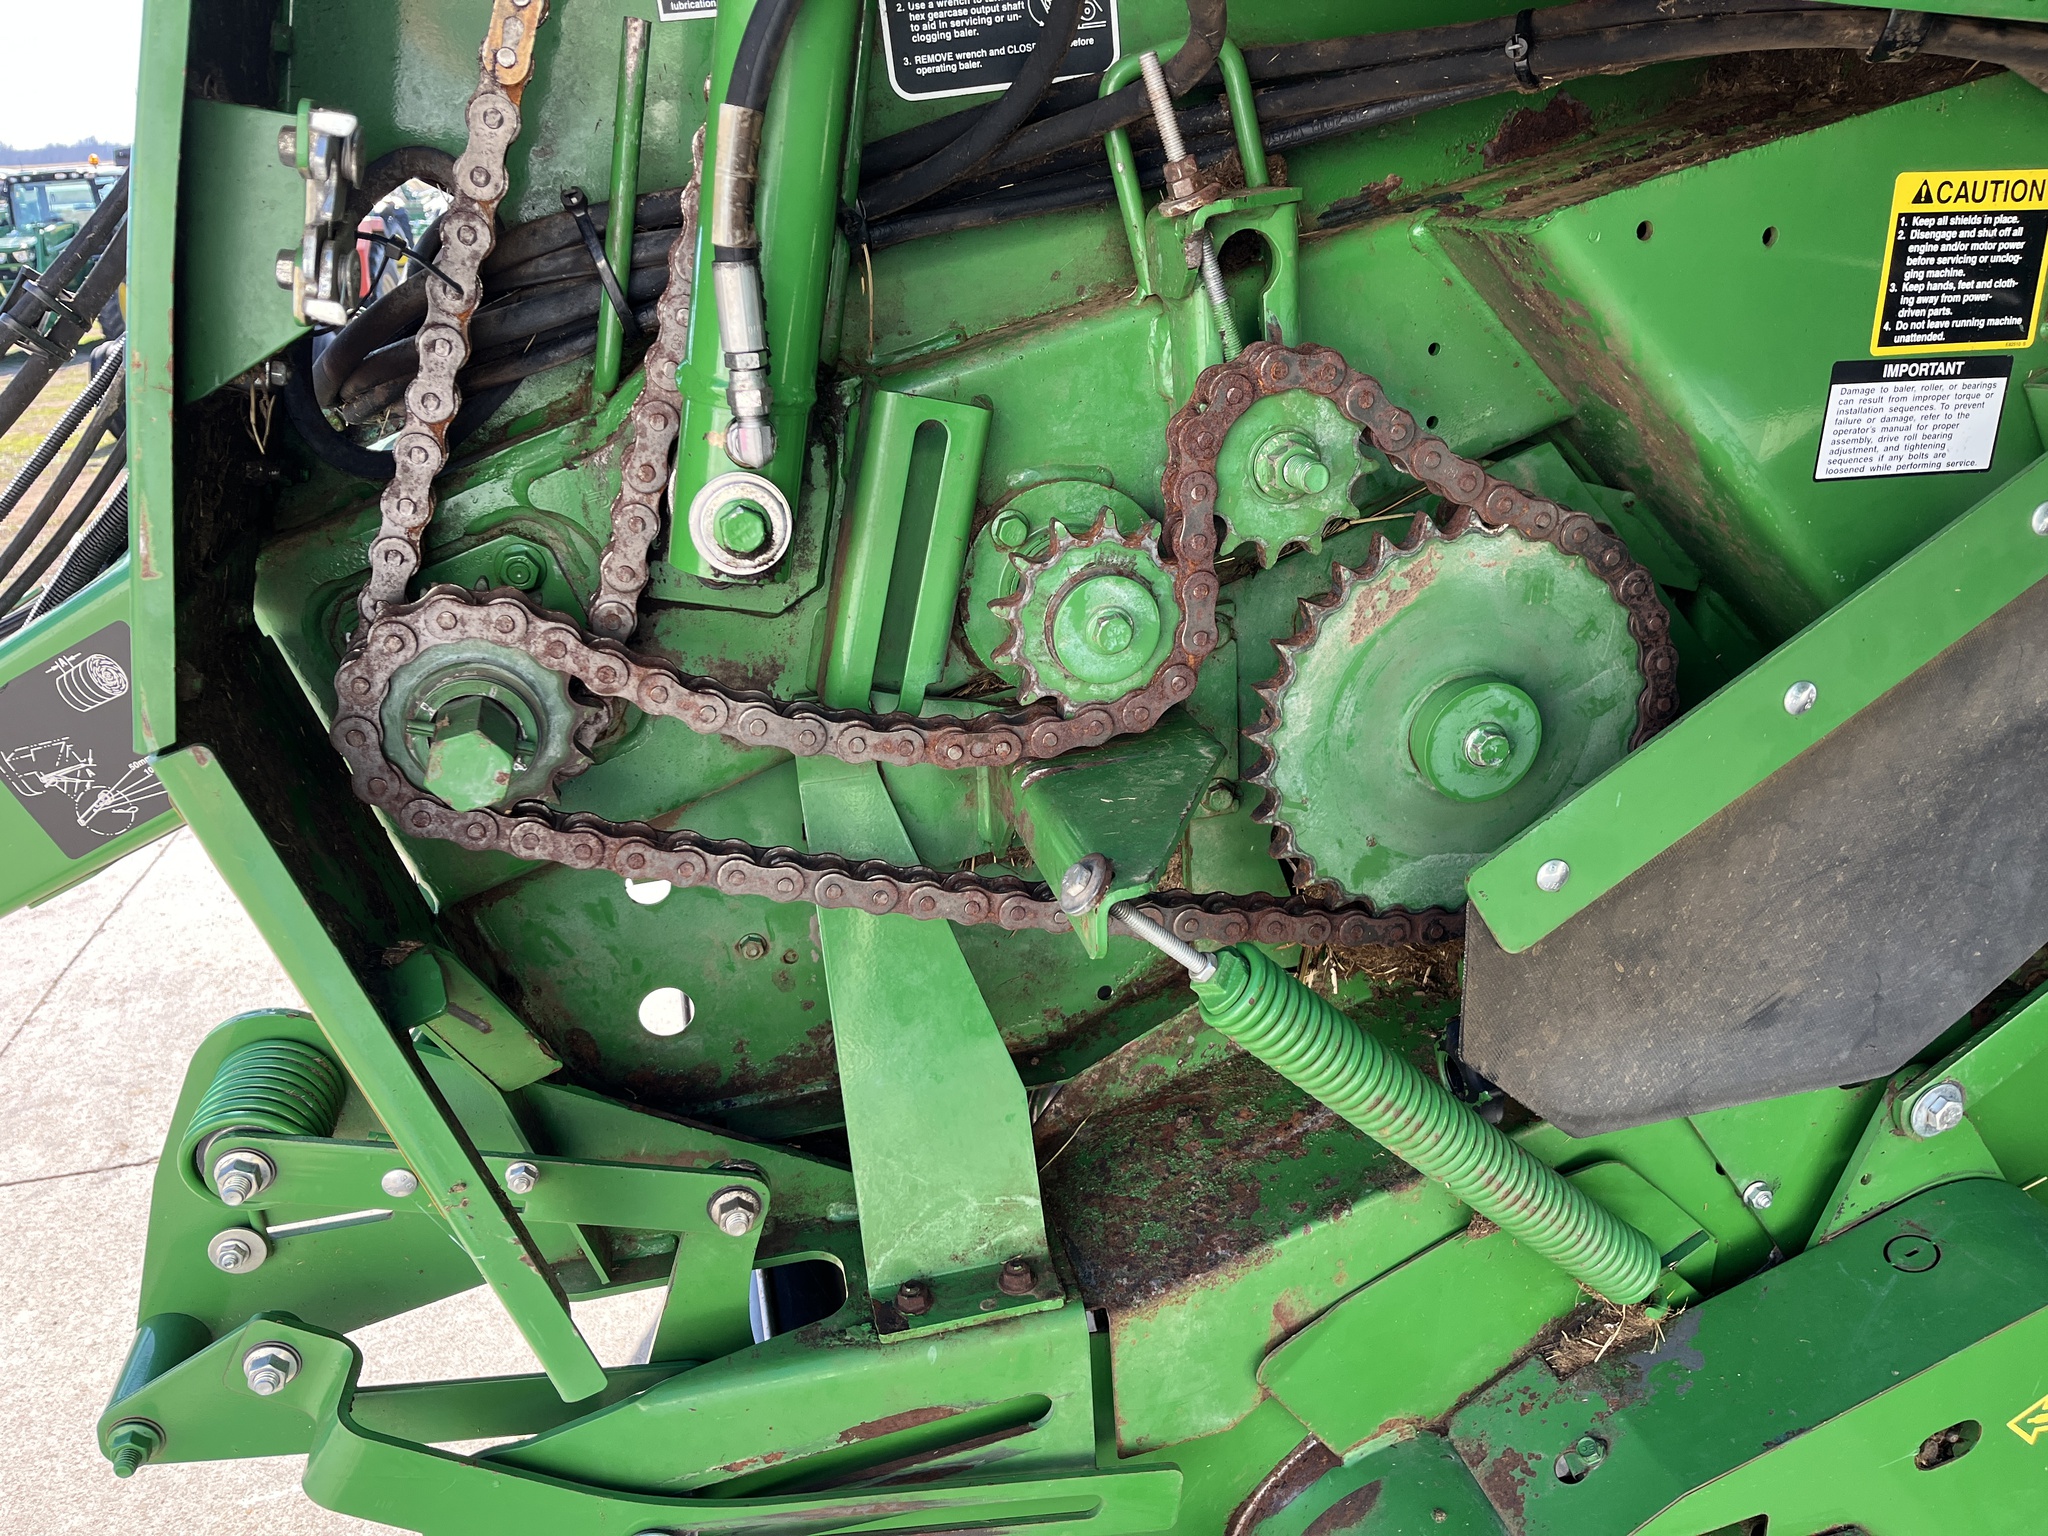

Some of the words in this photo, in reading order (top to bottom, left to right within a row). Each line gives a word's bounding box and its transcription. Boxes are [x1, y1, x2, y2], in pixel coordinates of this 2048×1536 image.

[670, 0, 716, 10] lubrication
[897, 3, 904, 12] 2.
[908, 2, 925, 11] Use
[909, 12, 925, 21] hex
[928, 9, 956, 21] gearcase
[971, 4, 1000, 15] output
[1002, 1, 1025, 11] shaft
[910, 24, 919, 32] to
[922, 21, 936, 30] aid
[939, 20, 948, 28] in
[950, 16, 992, 28] servicing
[1007, 13, 1022, 21] un-
[912, 30, 951, 43] clogging
[954, 28, 979, 38] baler.
[904, 57, 911, 66] 3.
[914, 52, 953, 64] REMOVE
[955, 49, 987, 60] wrench
[989, 46, 1005, 56] and
[1070, 37, 1094, 48] efore
[916, 63, 956, 76] operating
[959, 60, 982, 70] baler.
[1937, 179, 2046, 204] CAUTION
[1900, 216, 1908, 226] 1.
[1912, 216, 1935, 228] Keep
[1937, 216, 1948, 226] all
[1950, 214, 1982, 226] shields
[1983, 214, 1992, 224] in
[1993, 214, 2020, 227] place.
[1897, 231, 1906, 240] 2.
[1910, 229, 1957, 242] Disengage
[1959, 228, 1976, 238] and
[1977, 228, 1997, 238] shut
[1998, 227, 2012, 237] off
[2012, 227, 2024, 237] all
[1908, 243, 1938, 255] engine
[1940, 241, 1969, 252] and/or
[1970, 241, 1996, 251] motor
[1997, 241, 2026, 252] power
[1906, 255, 1935, 266] before
[1937, 254, 1977, 266] servicing
[1979, 255, 1989, 263] or
[1990, 253, 2023, 264] unclog-
[1904, 269, 1924, 281] ging
[1926, 267, 1966, 278] machine.
[1889, 283, 1897, 293] 3.
[1902, 282, 1925, 293] Keep
[1926, 280, 1956, 291] hands,
[1958, 279, 1975, 290] feet
[1976, 278, 1992, 288] and
[1994, 278, 2019, 288] cloth-
[1900, 295, 1914, 306] ing
[1916, 295, 1940, 306] away
[1941, 293, 1961, 303] from
[1962, 294, 1992, 304] power-
[1898, 308, 1926, 318] driven
[1927, 307, 1953, 318] parts.
[1884, 322, 1891, 331] 4.
[1896, 320, 1909, 330] Do
[1910, 320, 1926, 329] not
[1927, 318, 1950, 329] leave
[1951, 317, 1985, 329] running
[1986, 316, 2022, 326] machine
[1894, 332, 1946, 343] unattended.
[1882, 361, 1965, 378] IMPORTANT
[1840, 387, 1876, 396] Damage
[1881, 386, 1889, 394] to
[1893, 385, 1916, 393] baler,
[1921, 384, 1944, 392] roller,
[1962, 382, 1997, 390] bearings
[1859, 396, 1883, 404] result
[1888, 395, 1908, 403] from
[1912, 394, 1950, 403] improper
[1955, 392, 1980, 400] torque
[1836, 406, 1884, 416] installation
[1889, 404, 1936, 413] sequences.
[1954, 402, 1985, 411] prevent
[1835, 416, 1862, 425] failure
[1880, 414, 1916, 424] damage,
[1921, 413, 1940, 421] refer
[1881, 424, 1911, 433] manual
[1932, 422, 1959, 431] proper
[1831, 437, 1873, 446] assembly,
[1904, 433, 1917, 441] roll
[1922, 432, 1953, 441] bearing
[1829, 446, 1879, 456] adjustment,
[1884, 444, 1899, 452] and
[1904, 442, 1946, 451] tightening
[1828, 456, 1873, 466] sequences
[1878, 453, 1884, 462] if
[1889, 454, 1903, 462] any
[1908, 452, 1929, 460] bolts
[1826, 465, 1865, 475] loosened
[1870, 464, 1891, 472] while
[1896, 461, 1941, 471] performing
[1946, 460, 1977, 468] service.
